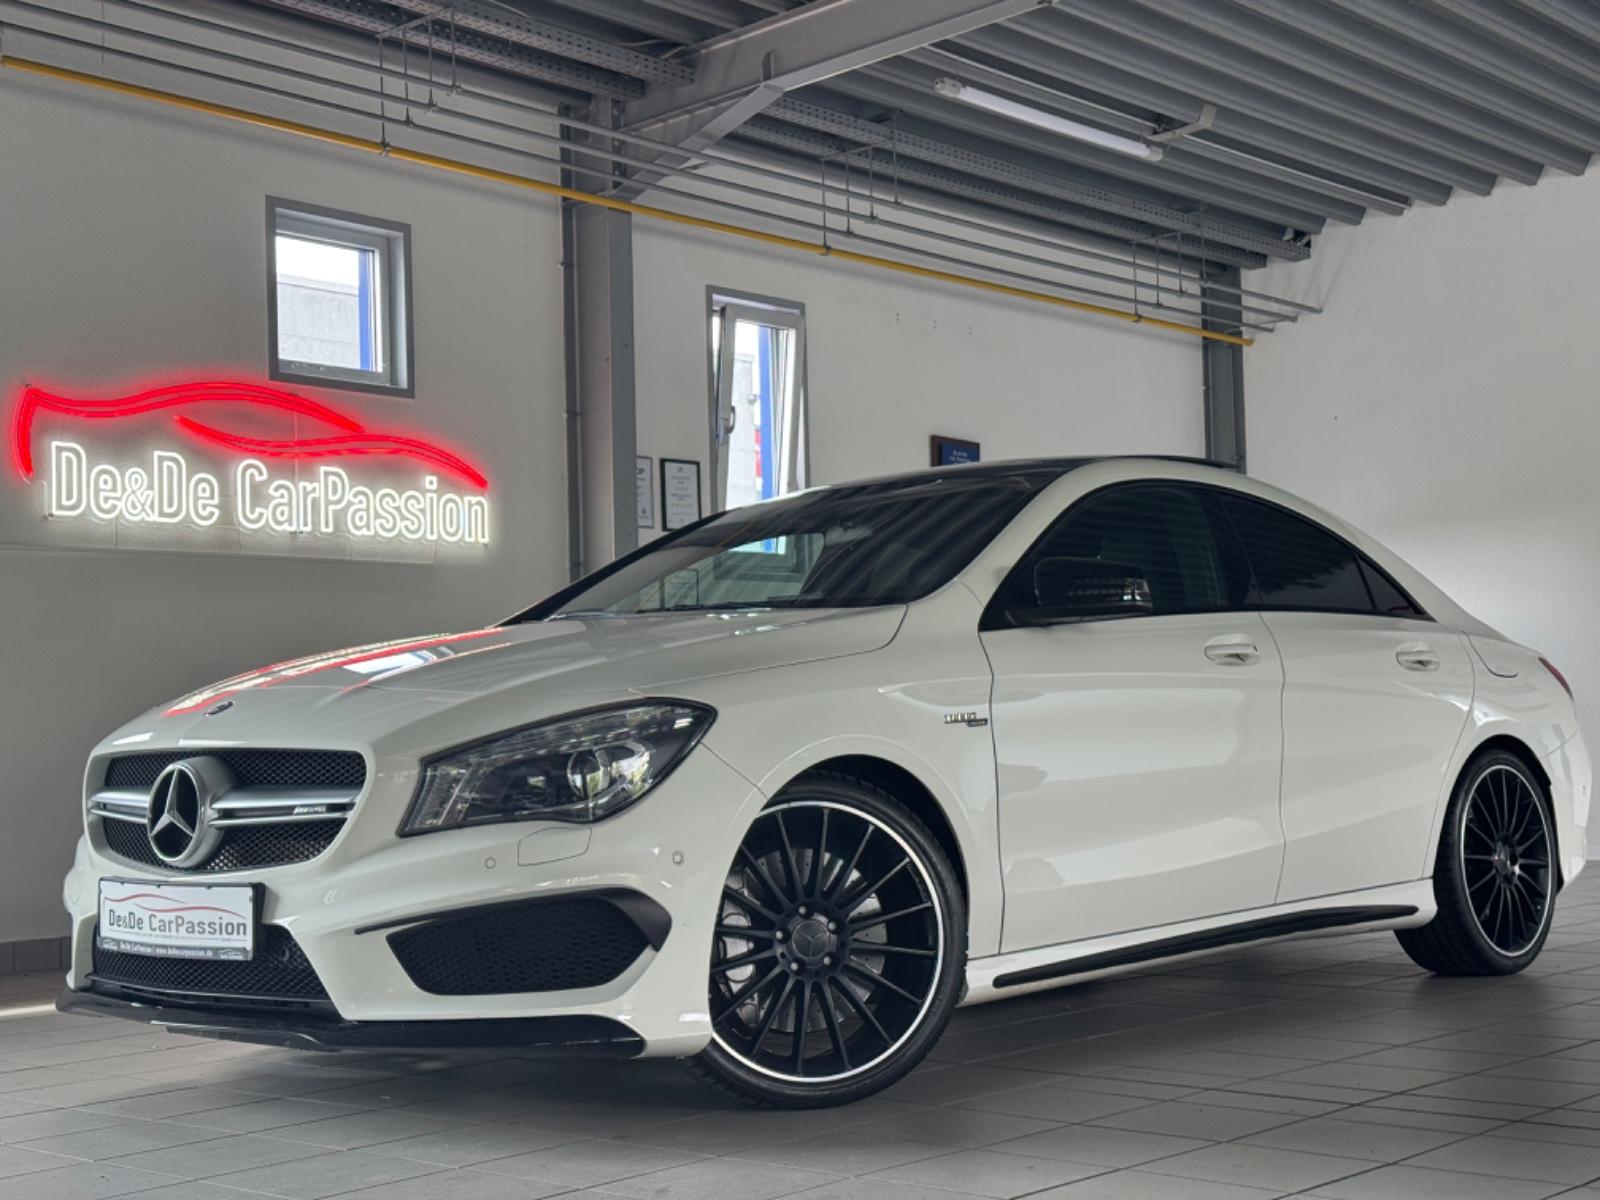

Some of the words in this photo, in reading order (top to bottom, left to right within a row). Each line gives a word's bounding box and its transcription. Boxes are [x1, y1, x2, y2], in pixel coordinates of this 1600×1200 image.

[51, 441, 220, 526] De&De
[237, 458, 490, 543] CarPassion
[109, 909, 144, 930] De&De
[149, 914, 247, 936] CarPassion
